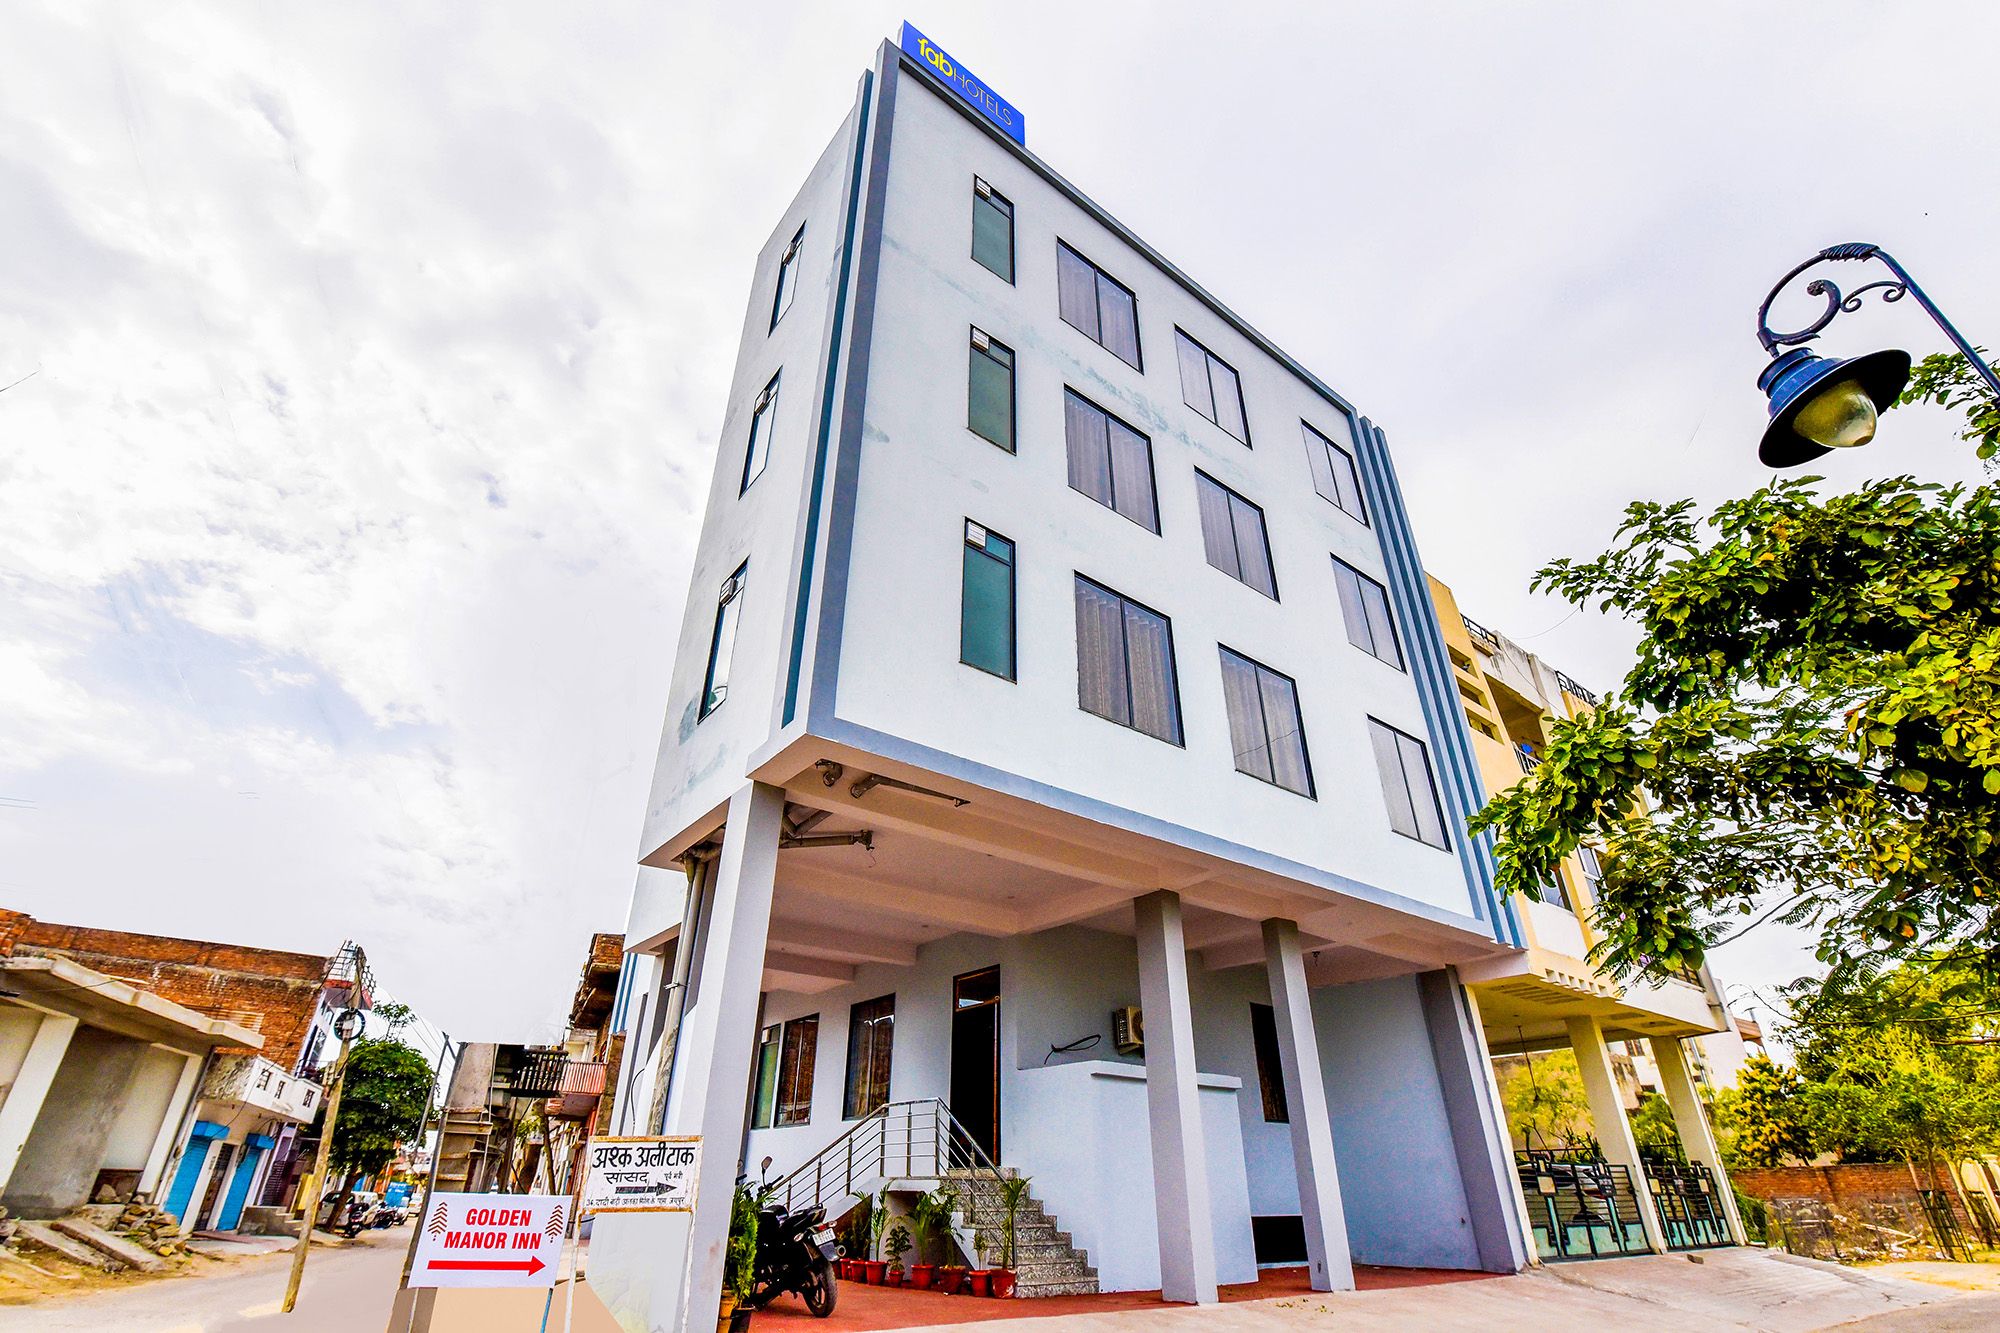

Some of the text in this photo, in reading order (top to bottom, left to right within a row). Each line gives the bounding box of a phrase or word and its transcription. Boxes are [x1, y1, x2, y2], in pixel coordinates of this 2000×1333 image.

[917, 38, 1012, 126] fabHOTELS
[604, 1170, 649, 1184] सांसद
[465, 1208, 532, 1227] GOLDEN
[443, 1231, 542, 1250] MANOR INN
